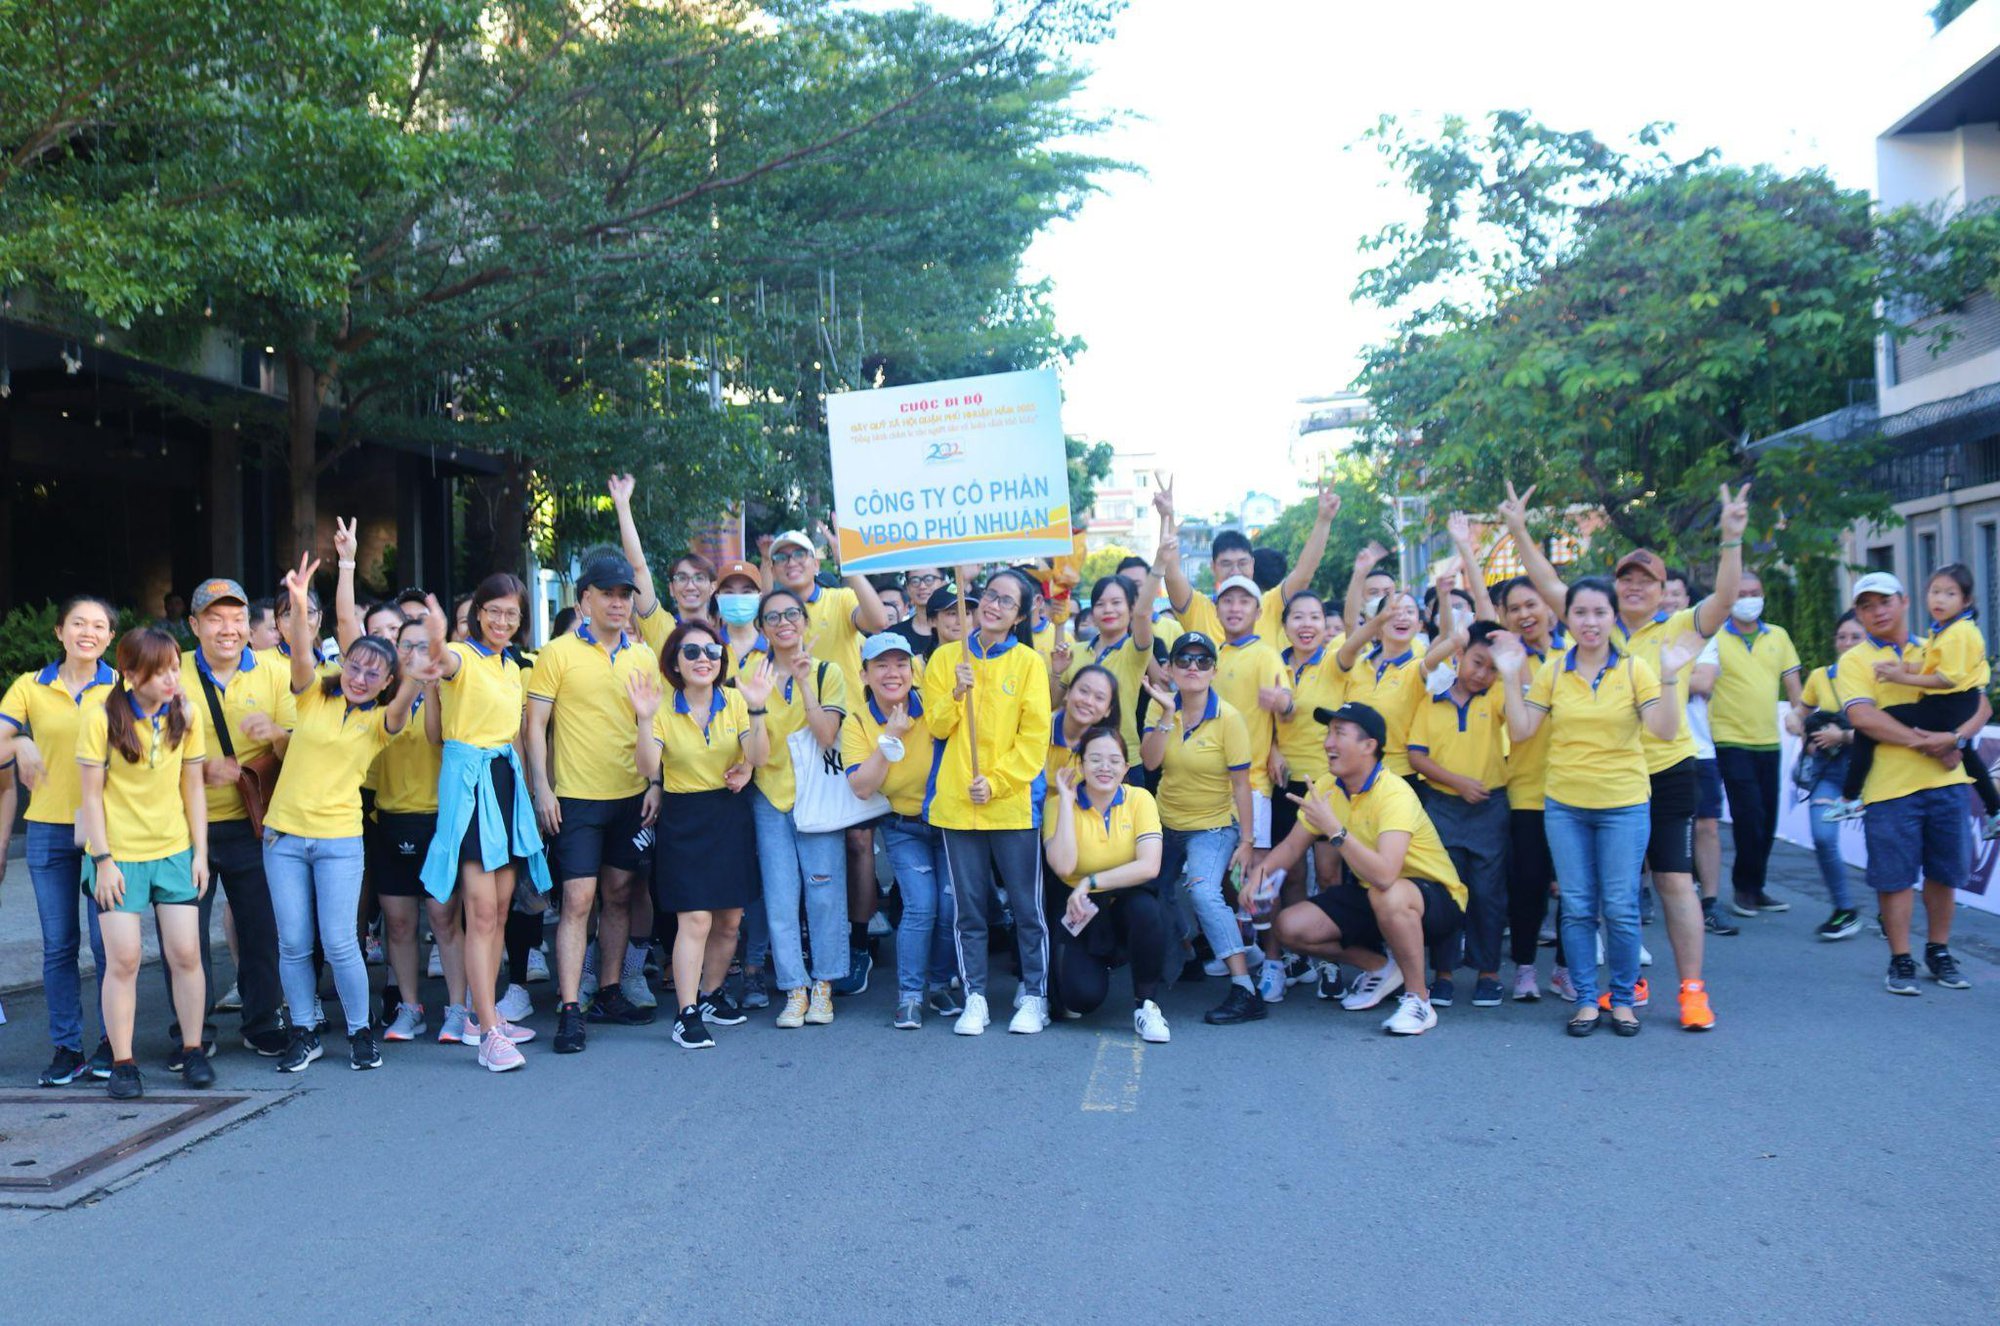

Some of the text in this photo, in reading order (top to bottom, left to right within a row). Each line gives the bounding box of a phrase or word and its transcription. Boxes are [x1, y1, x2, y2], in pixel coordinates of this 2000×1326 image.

[900, 398, 939, 413] CUỘC
[964, 391, 983, 405] BỘ
[854, 489, 915, 516] CÔNG
[920, 487, 945, 509] TY
[859, 506, 1049, 546] VBĐQ PHÚ NHUẬN
